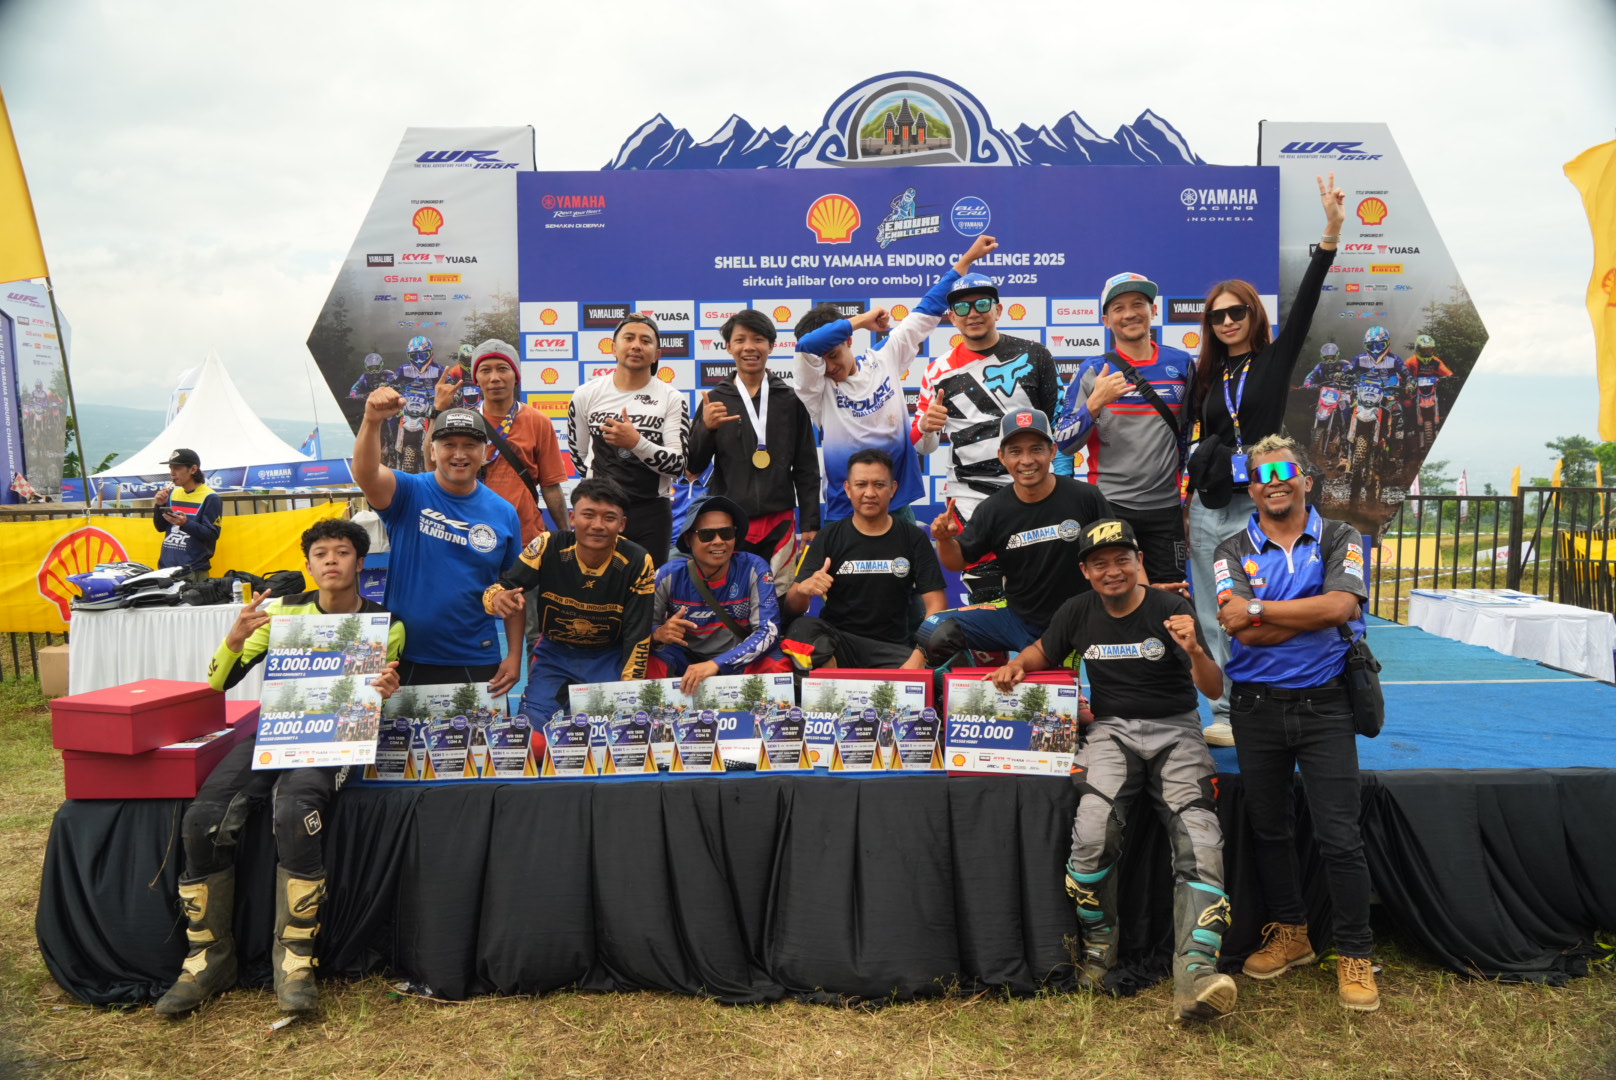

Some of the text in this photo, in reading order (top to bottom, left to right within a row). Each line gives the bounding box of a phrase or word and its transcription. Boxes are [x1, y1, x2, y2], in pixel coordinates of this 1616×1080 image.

[1280, 142, 1366, 153] WR
[416, 150, 503, 162] WR
[557, 195, 606, 208] YAMAHA
[1198, 189, 1258, 204] YAMAHA
[885, 216, 940, 231] ENDURO
[885, 226, 939, 239] CHALLENGE
[714, 253, 1065, 268] SHELL BLU CRU YAMAHA ENDURO CLLENGE 2025
[742, 274, 1037, 288] sirkuit jalibar (oro oro ombo) 2025
[589, 308, 625, 319] YAMALUBE
[654, 312, 690, 321] YUASA
[838, 306, 859, 315] LUBE
[534, 339, 566, 347] KYB
[660, 338, 683, 347] ALUBE
[1065, 338, 1100, 347] YUASA
[266, 468, 292, 477] YAMAHA
[120, 482, 146, 492] LIVE
[421, 508, 471, 531] WR
[1022, 527, 1056, 541] YAMAHA
[270, 648, 304, 656] JUARA
[1101, 645, 1138, 655] YAMAHA
[268, 657, 341, 671] 3.000.000
[632, 643, 649, 679] MAHA
[262, 712, 296, 720] JUARA
[950, 714, 996, 724] JUARA 4
[260, 719, 334, 735] 2.000.000
[805, 721, 835, 734] 500.
[950, 724, 1014, 740] 750.000
